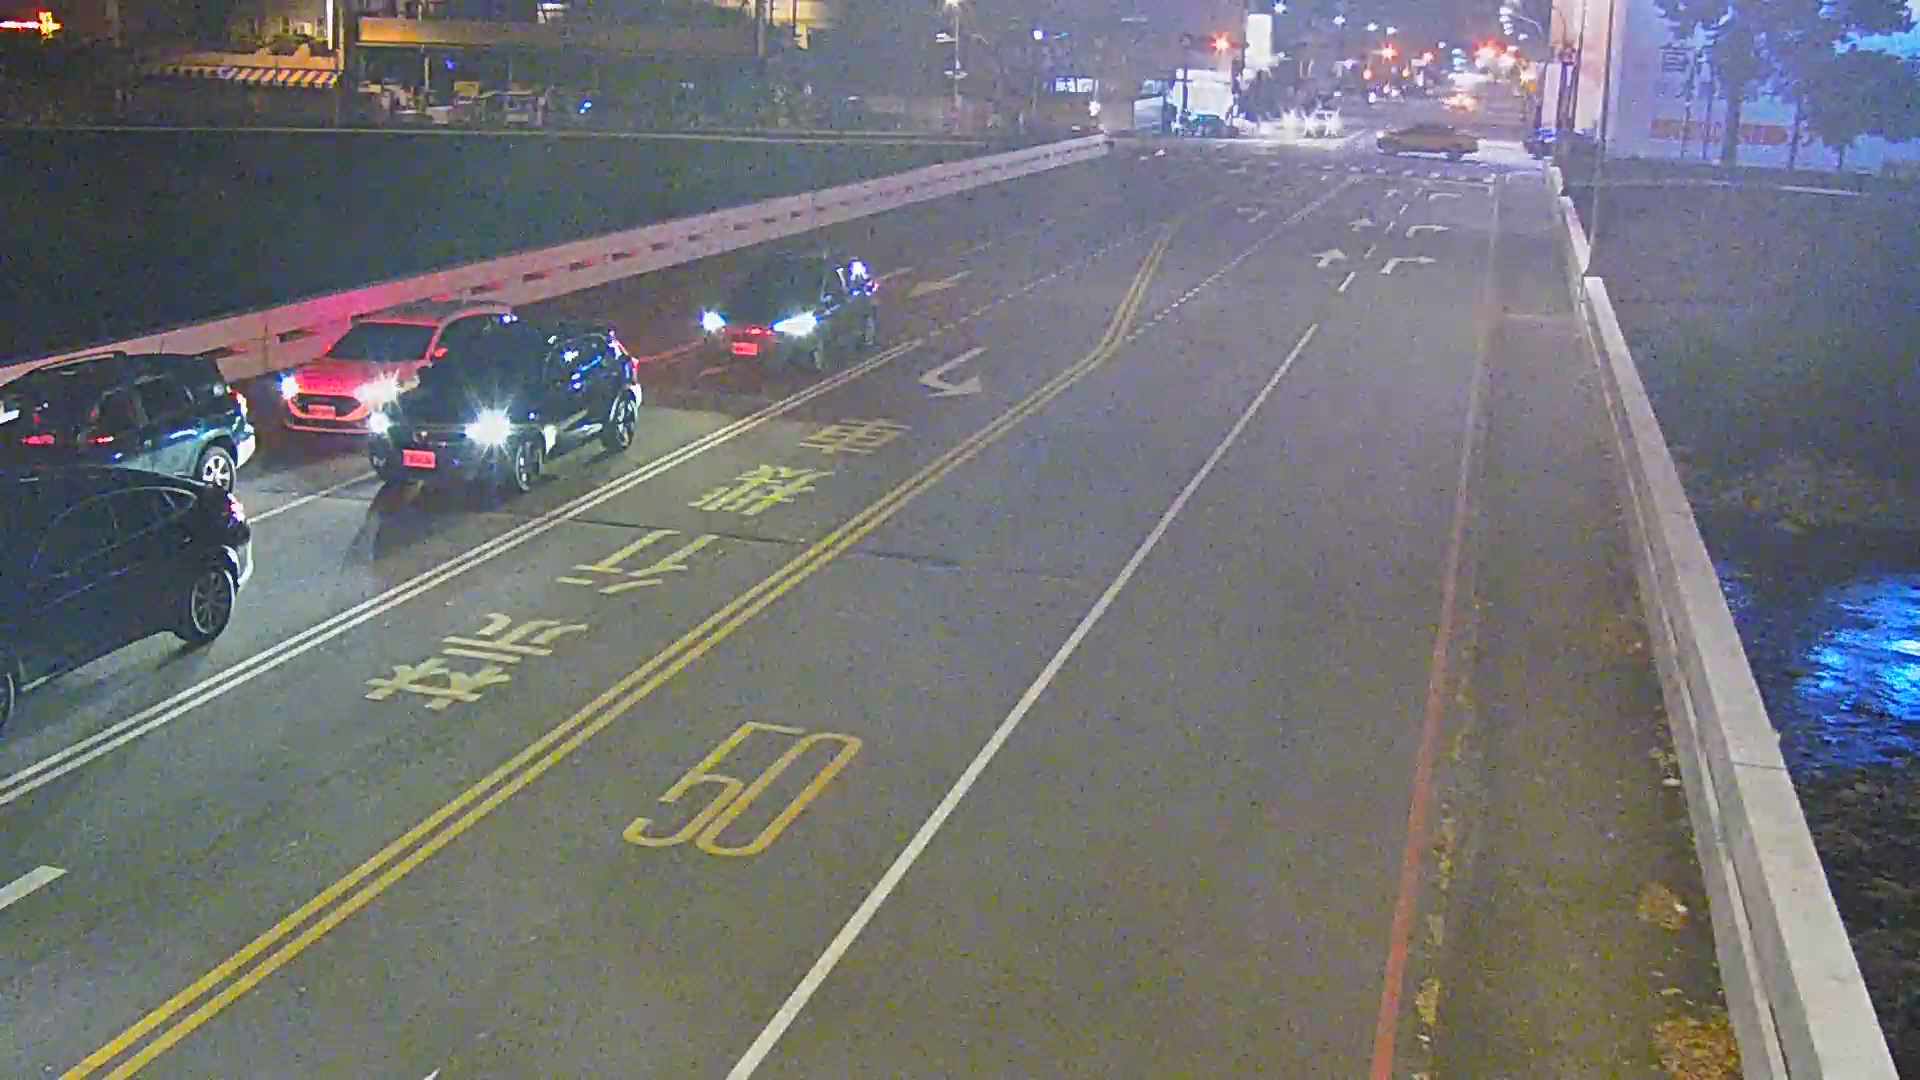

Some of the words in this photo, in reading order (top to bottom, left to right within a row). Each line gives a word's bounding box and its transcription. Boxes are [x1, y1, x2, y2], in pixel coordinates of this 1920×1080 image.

[364, 421, 908, 709] 禁行機車
[623, 721, 863, 857] 50
